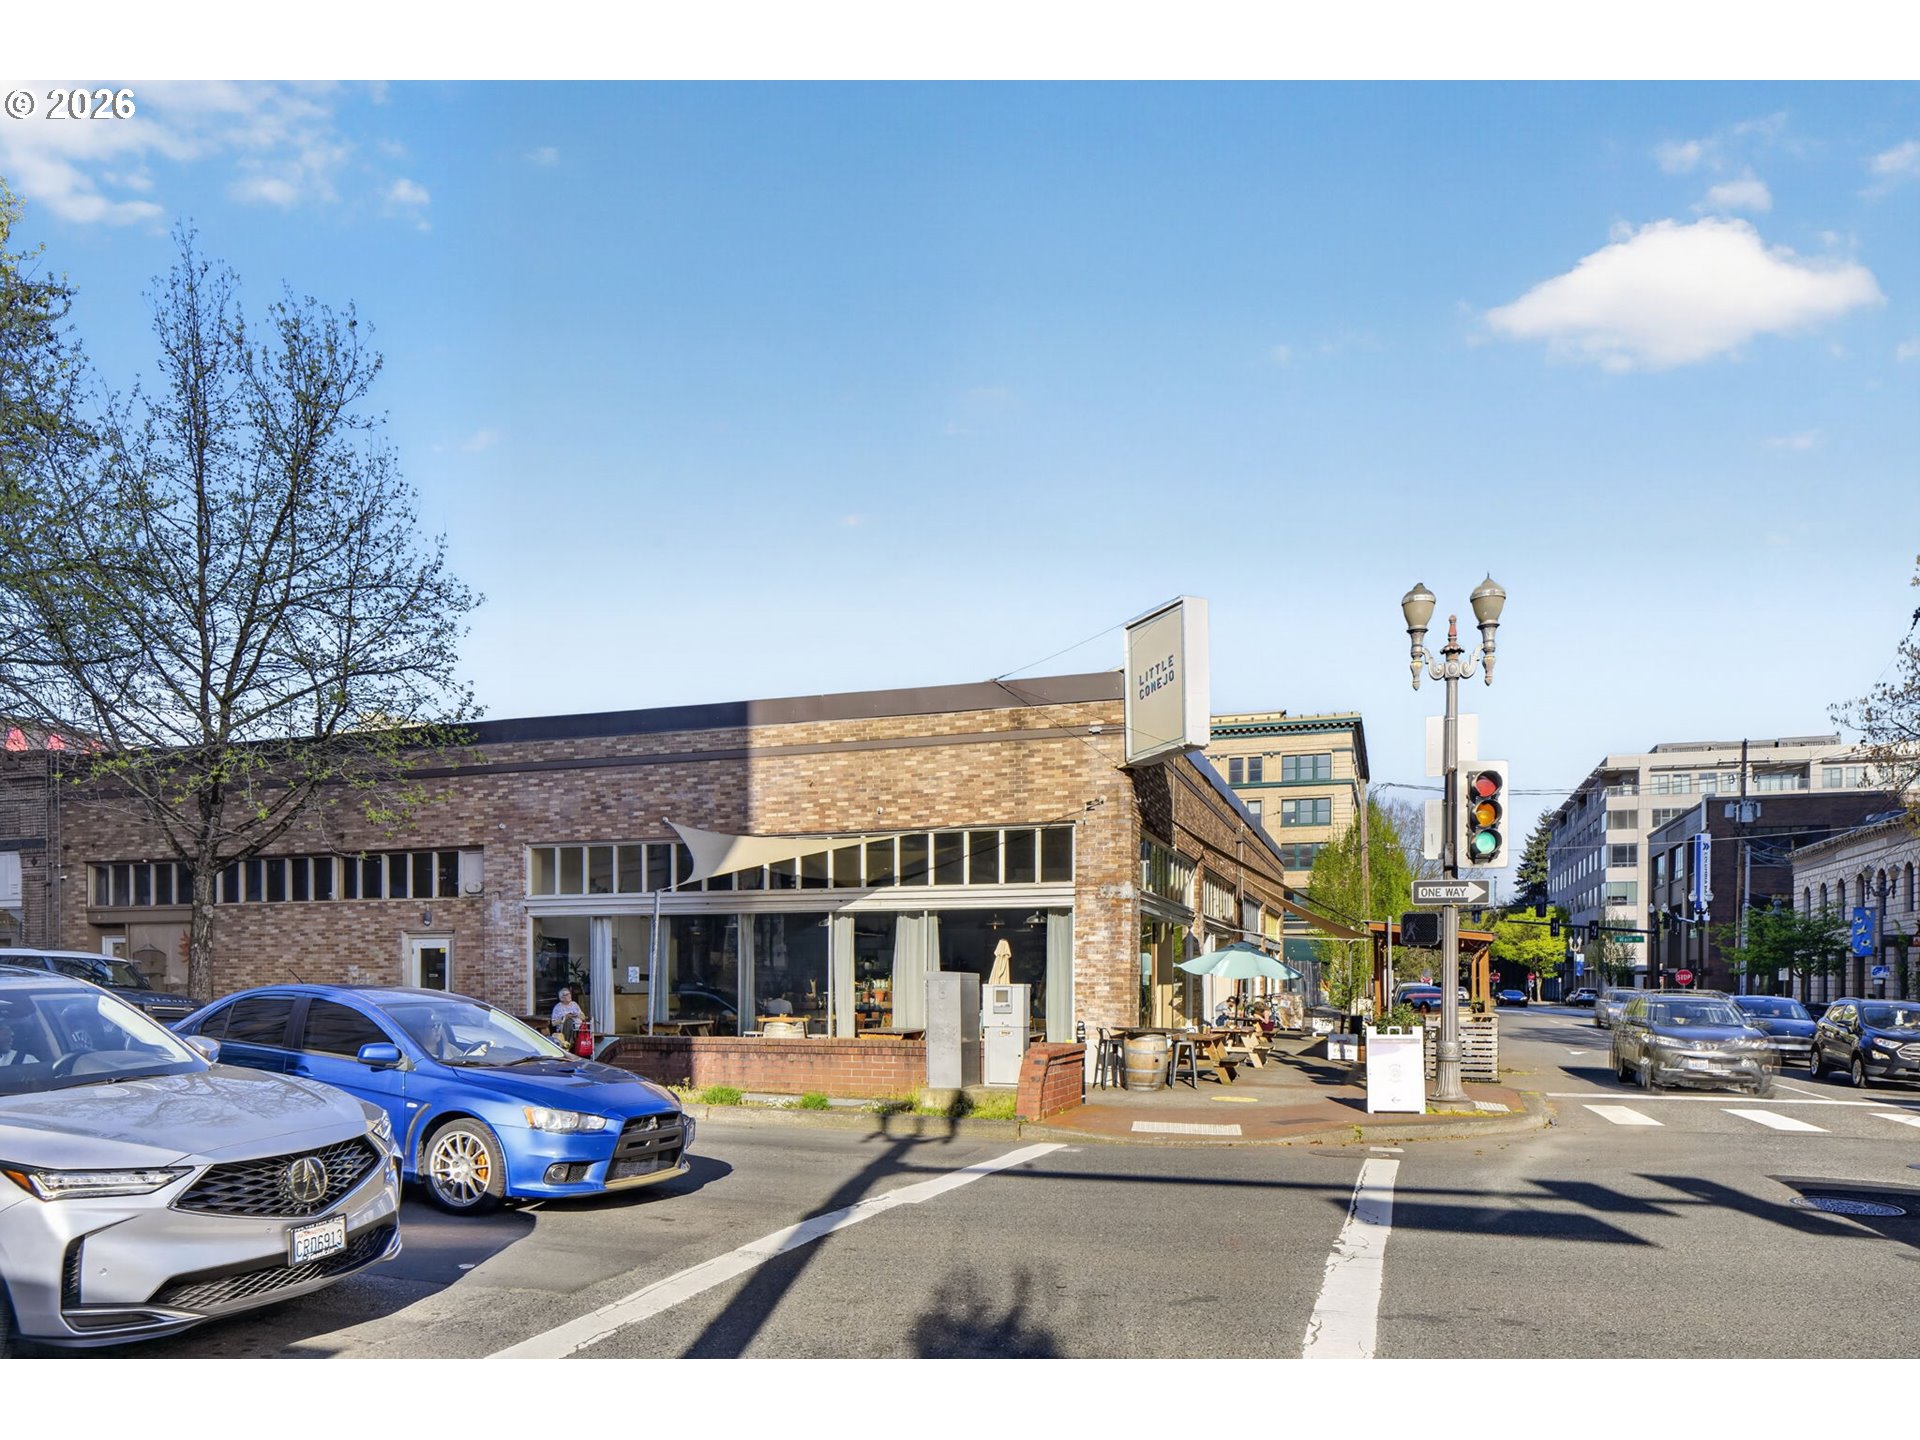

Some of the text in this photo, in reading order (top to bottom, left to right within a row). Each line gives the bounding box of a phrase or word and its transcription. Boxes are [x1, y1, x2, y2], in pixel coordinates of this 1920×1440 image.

[1139, 654, 1174, 686] LITTLE
[1139, 670, 1175, 700] CONEJO
[1420, 888, 1467, 897] ONE WAY
